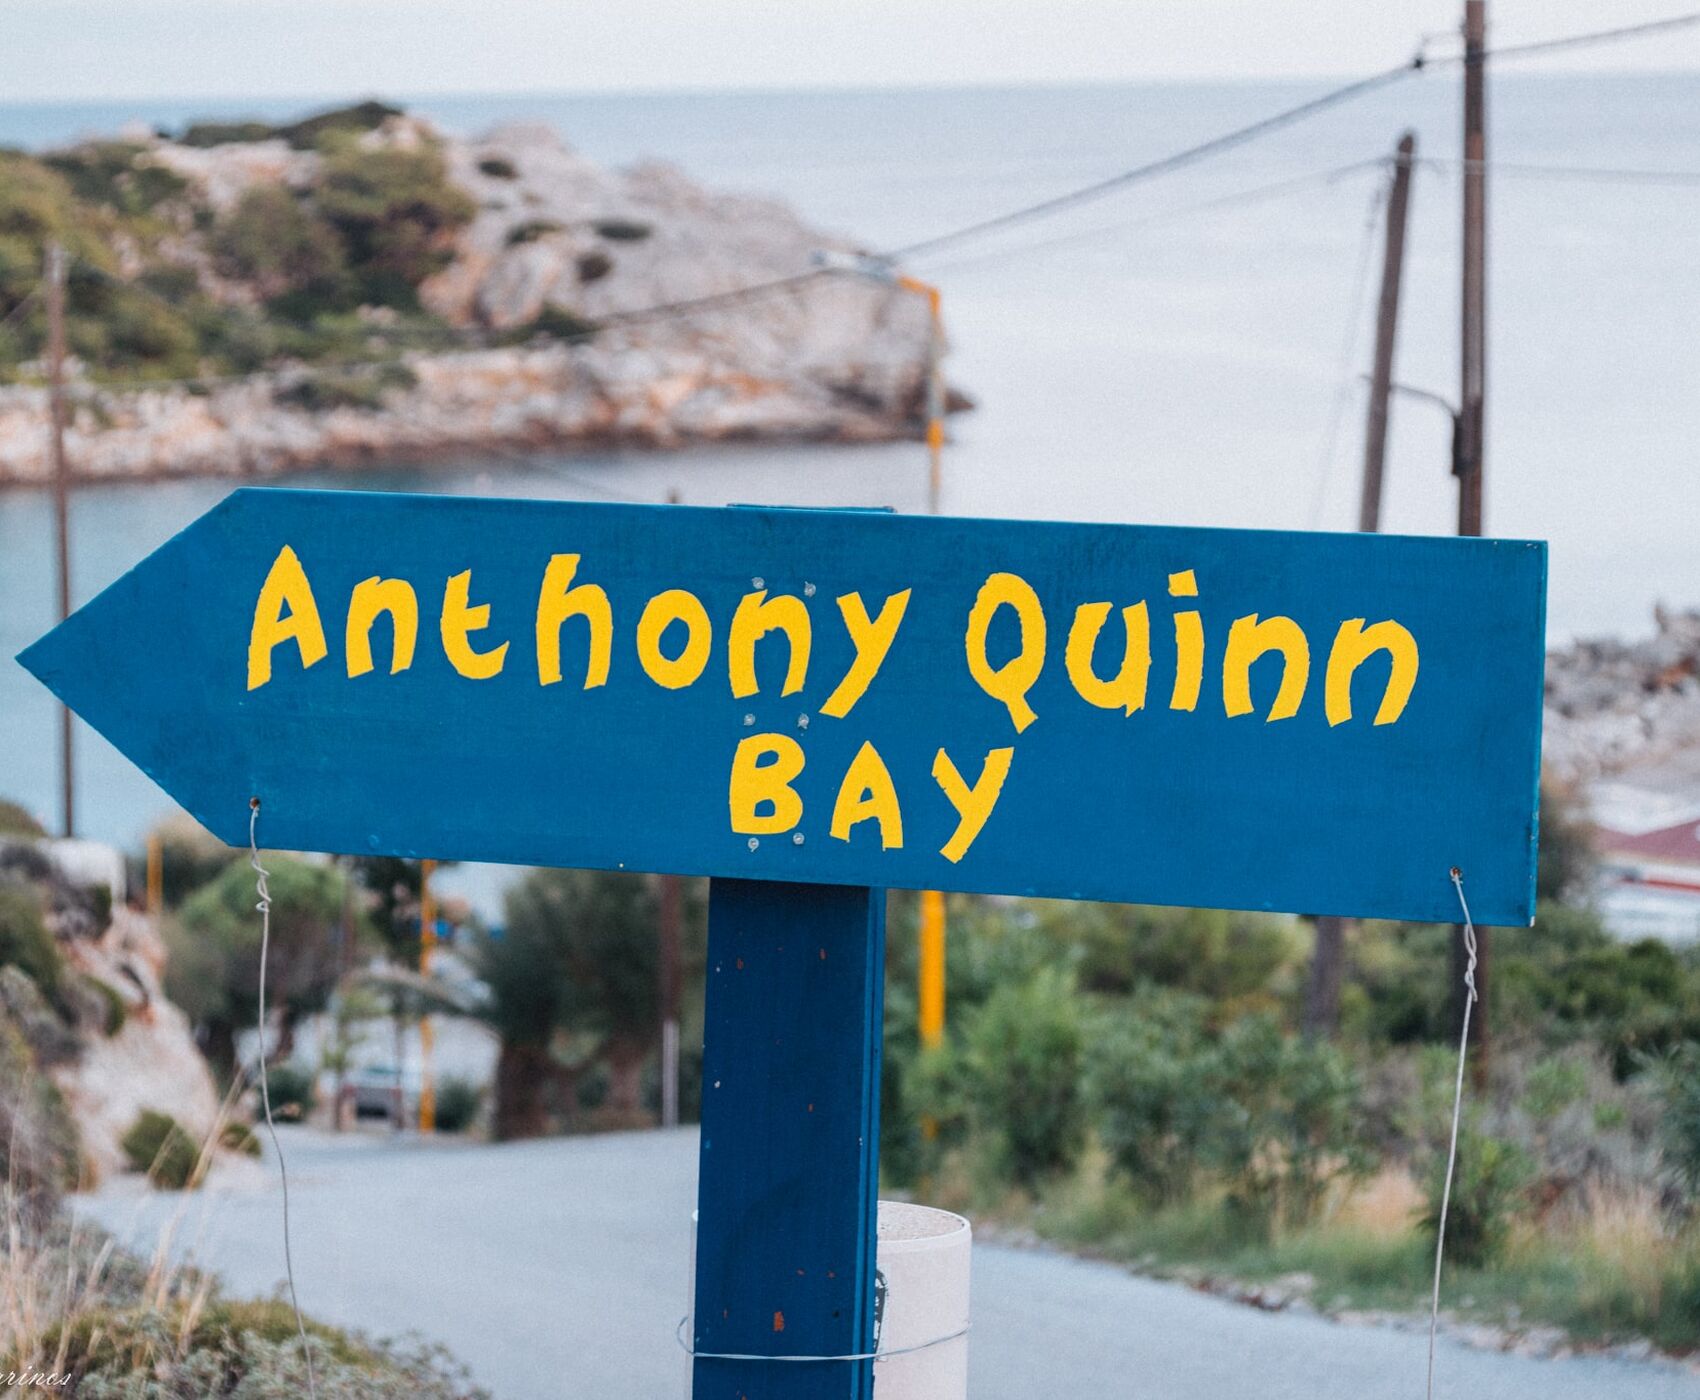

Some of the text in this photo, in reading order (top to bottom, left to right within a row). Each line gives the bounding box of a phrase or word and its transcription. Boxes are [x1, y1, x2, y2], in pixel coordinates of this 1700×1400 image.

[247, 545, 1419, 732] Anthony Quinn
[729, 733, 1014, 863] BAY
